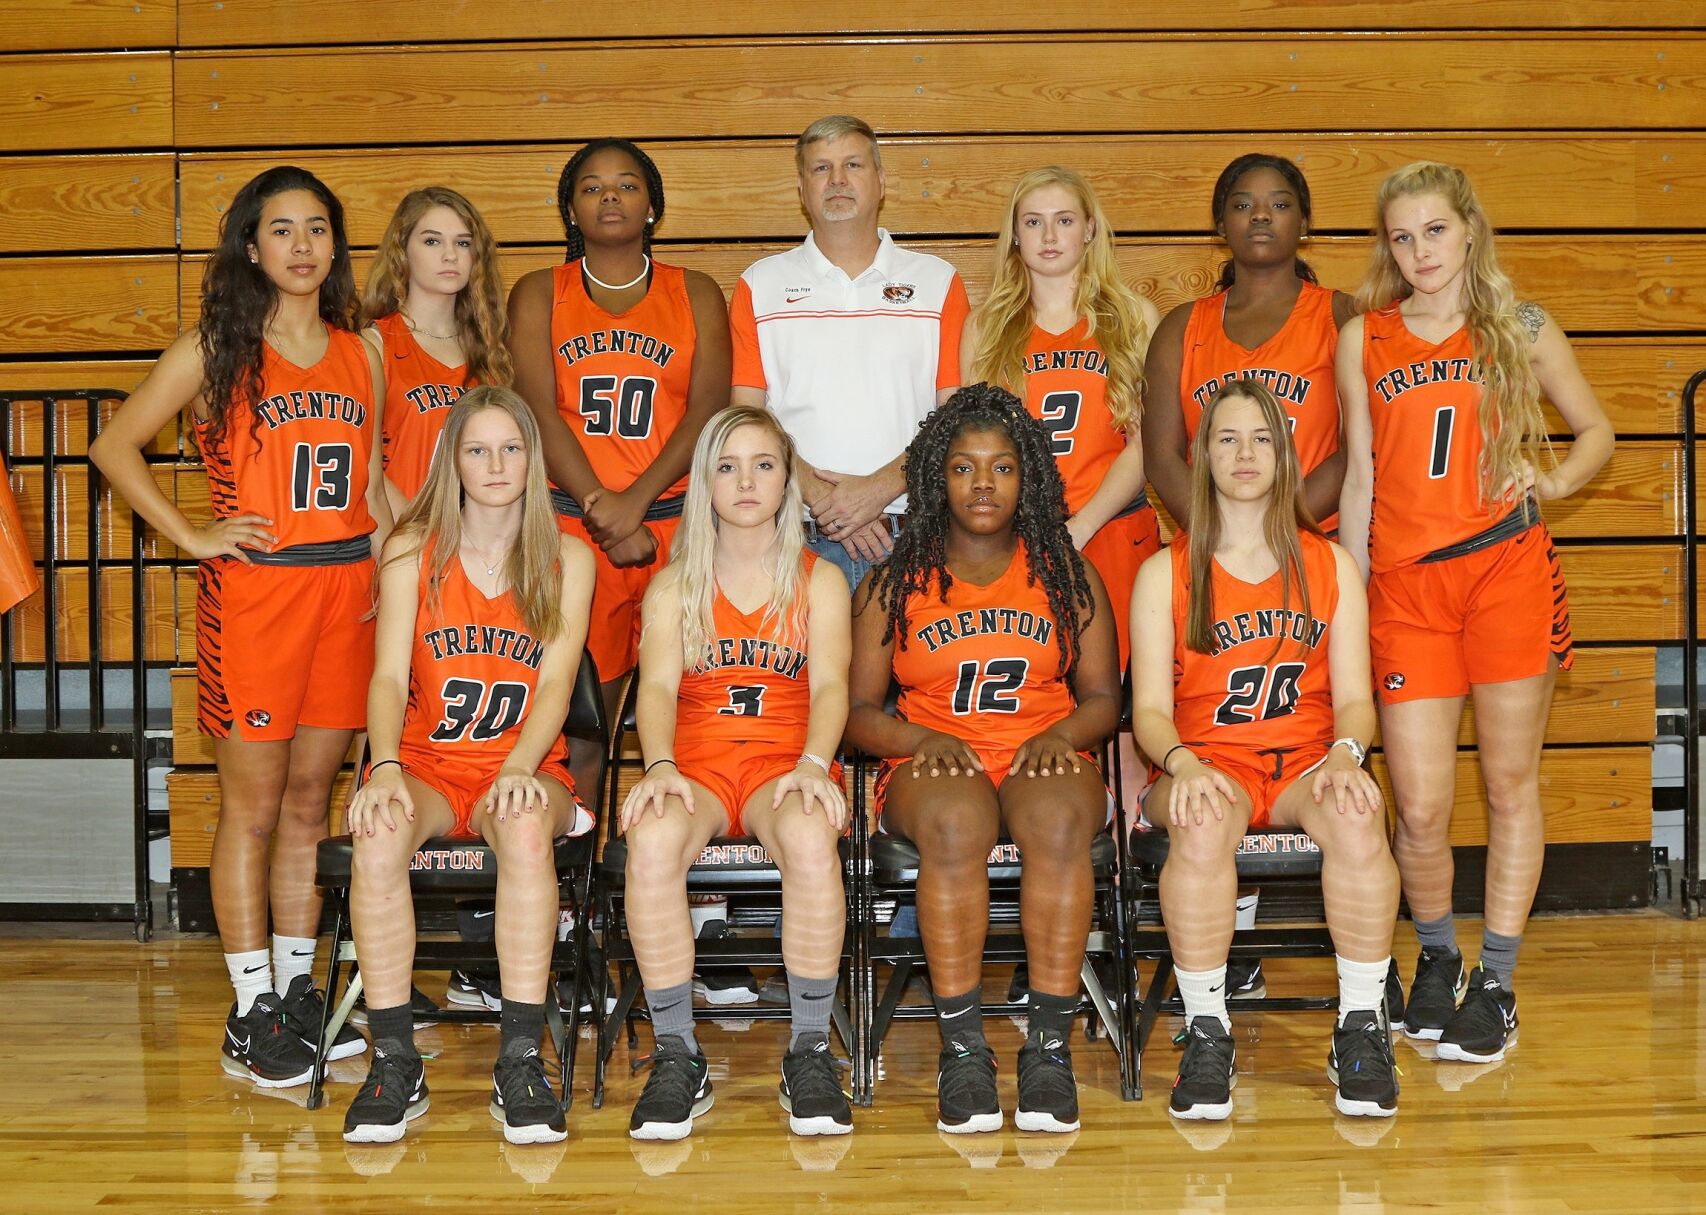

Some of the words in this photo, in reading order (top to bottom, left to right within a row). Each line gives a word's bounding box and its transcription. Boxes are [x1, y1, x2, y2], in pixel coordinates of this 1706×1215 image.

[557, 329, 675, 368] TRENTON
[1004, 349, 1109, 384] ENTO
[580, 375, 657, 440] 50
[1041, 390, 1082, 456] 2
[1429, 406, 1456, 479] 1
[291, 442, 353, 512] 13
[424, 624, 544, 671] TRENTON
[916, 608, 1053, 652] TRENTON
[1210, 609, 1328, 657] RENTON
[428, 676, 530, 742] 30
[952, 657, 1030, 716] 12
[1213, 662, 1306, 726] 20
[409, 850, 484, 870] NTON
